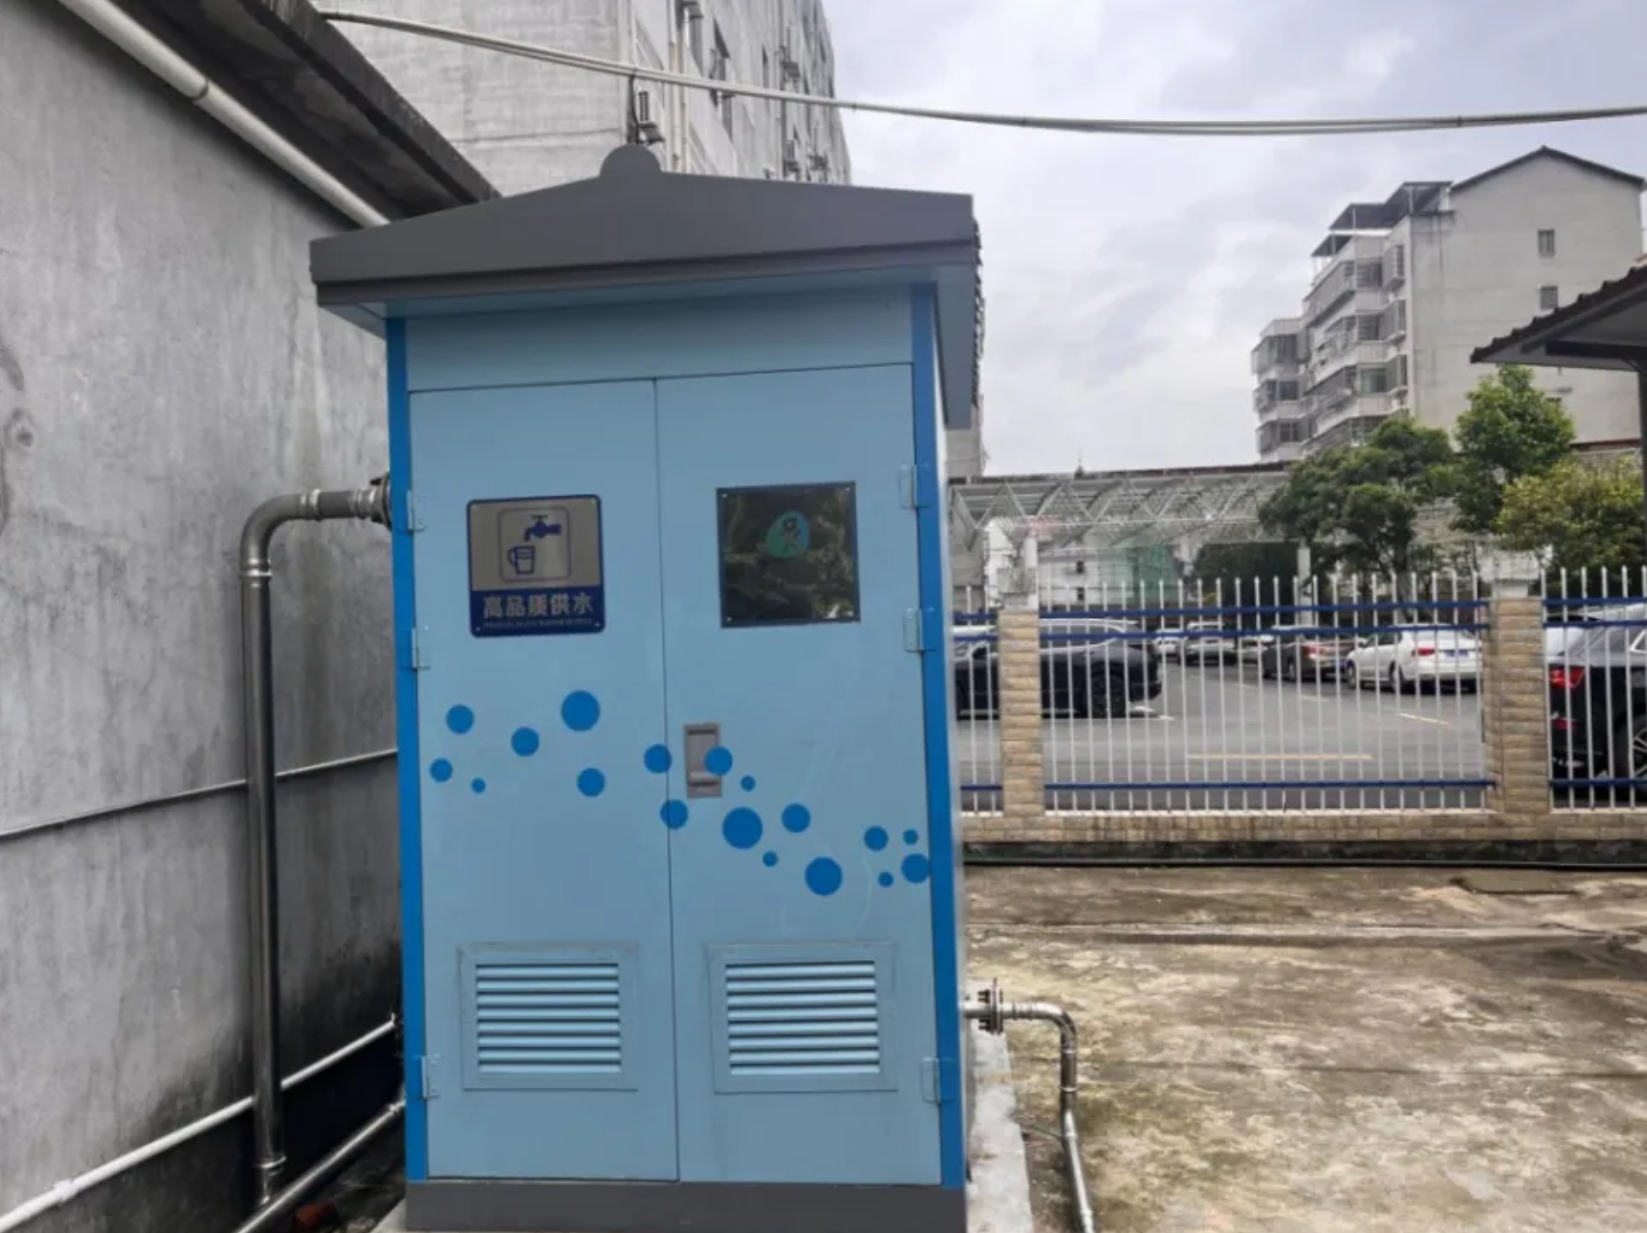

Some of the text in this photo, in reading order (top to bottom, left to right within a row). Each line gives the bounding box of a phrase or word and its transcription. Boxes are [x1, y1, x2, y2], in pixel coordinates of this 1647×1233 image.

[483, 591, 594, 619] 高品质供水
